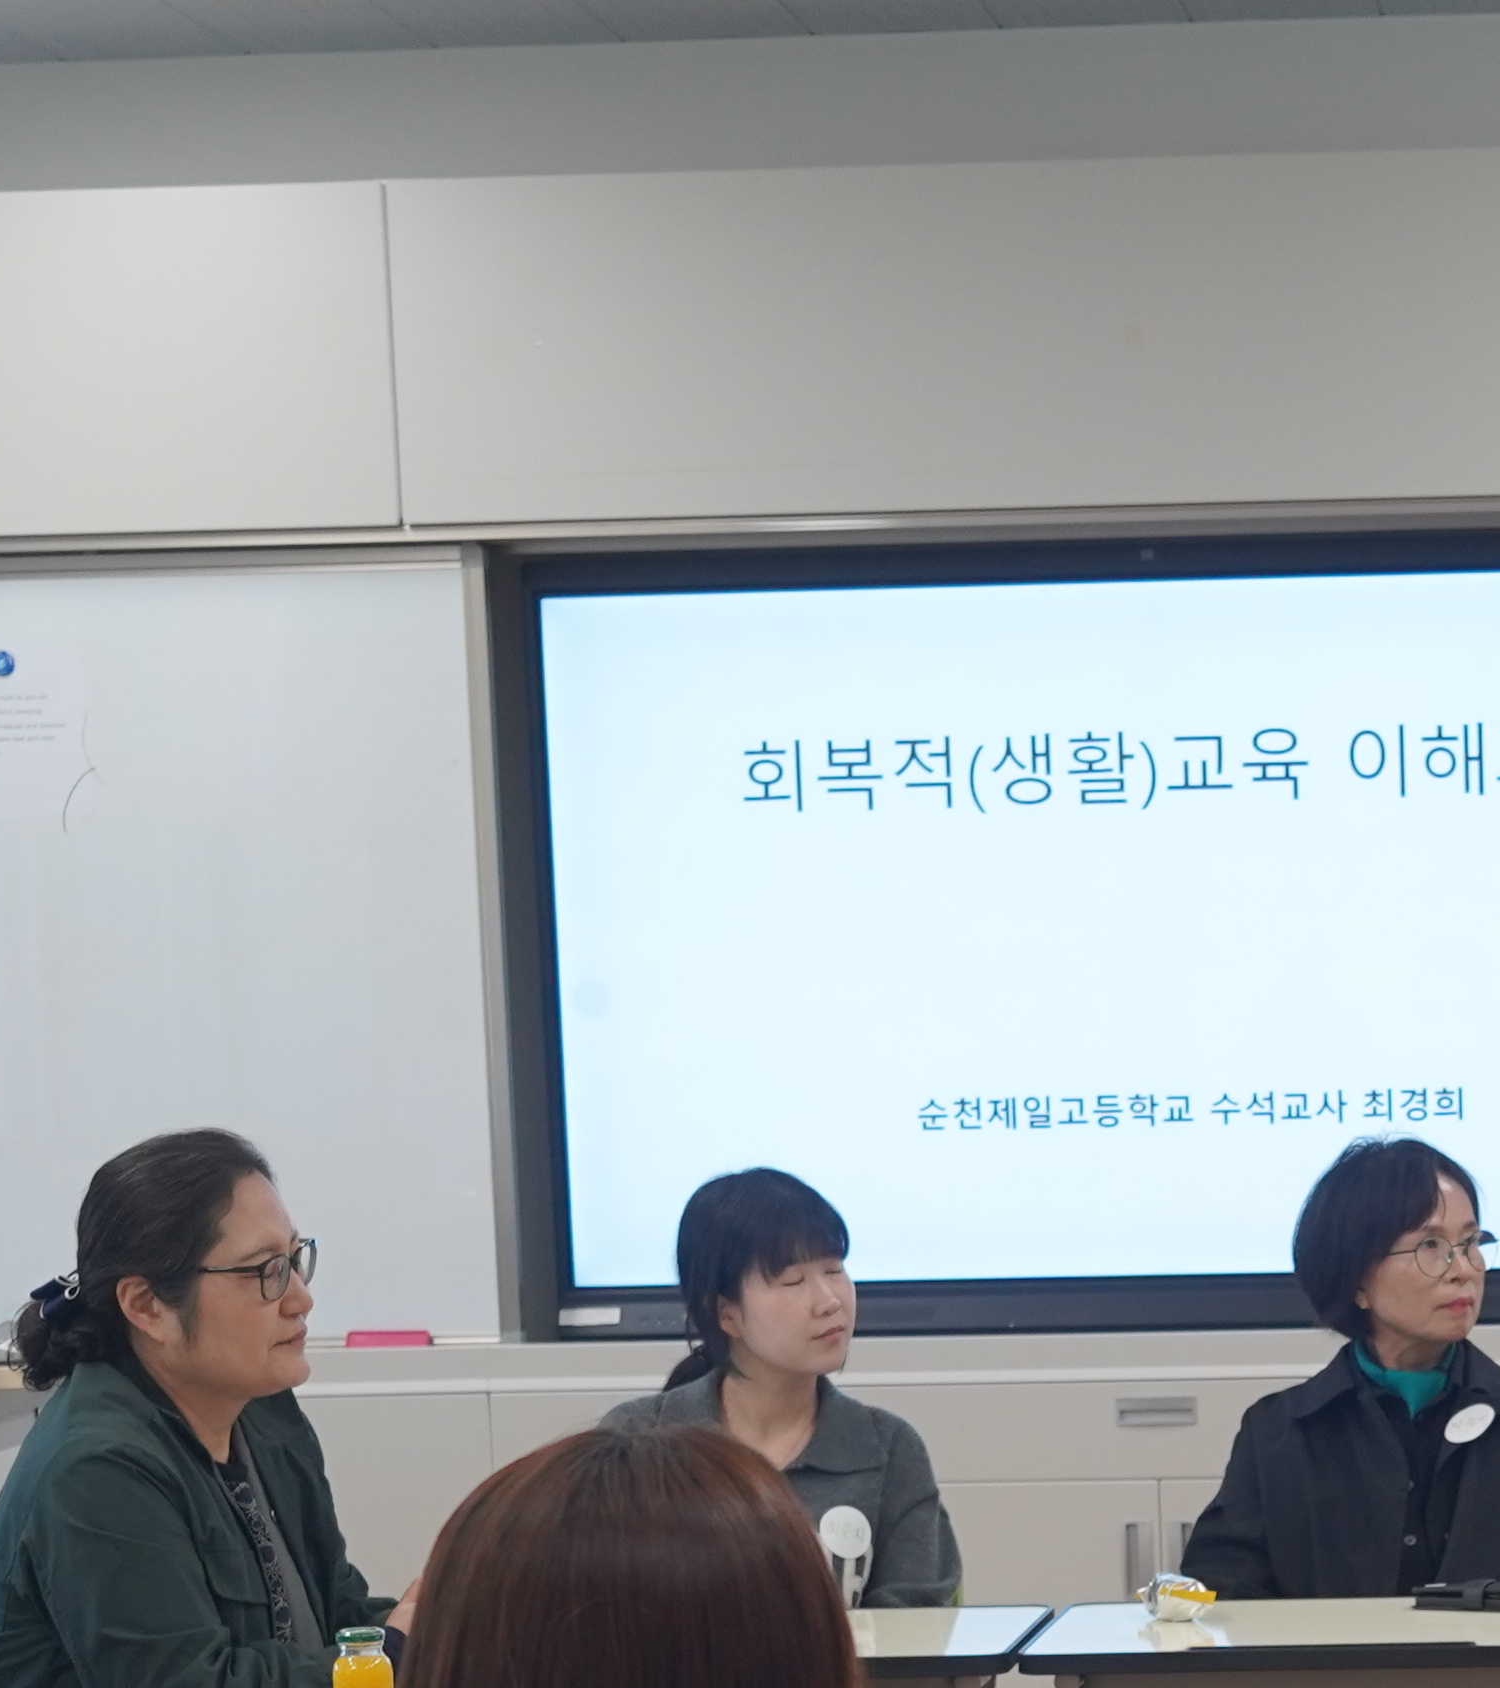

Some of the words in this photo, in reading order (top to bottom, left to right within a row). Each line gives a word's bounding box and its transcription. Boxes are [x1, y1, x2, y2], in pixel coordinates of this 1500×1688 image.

[742, 726, 1311, 815] 회복적(생활)교육
[916, 1092, 1196, 1132] 순천제일고등학교
[1209, 1088, 1350, 1127] 수석교사
[1361, 1085, 1465, 1124] 최경희
